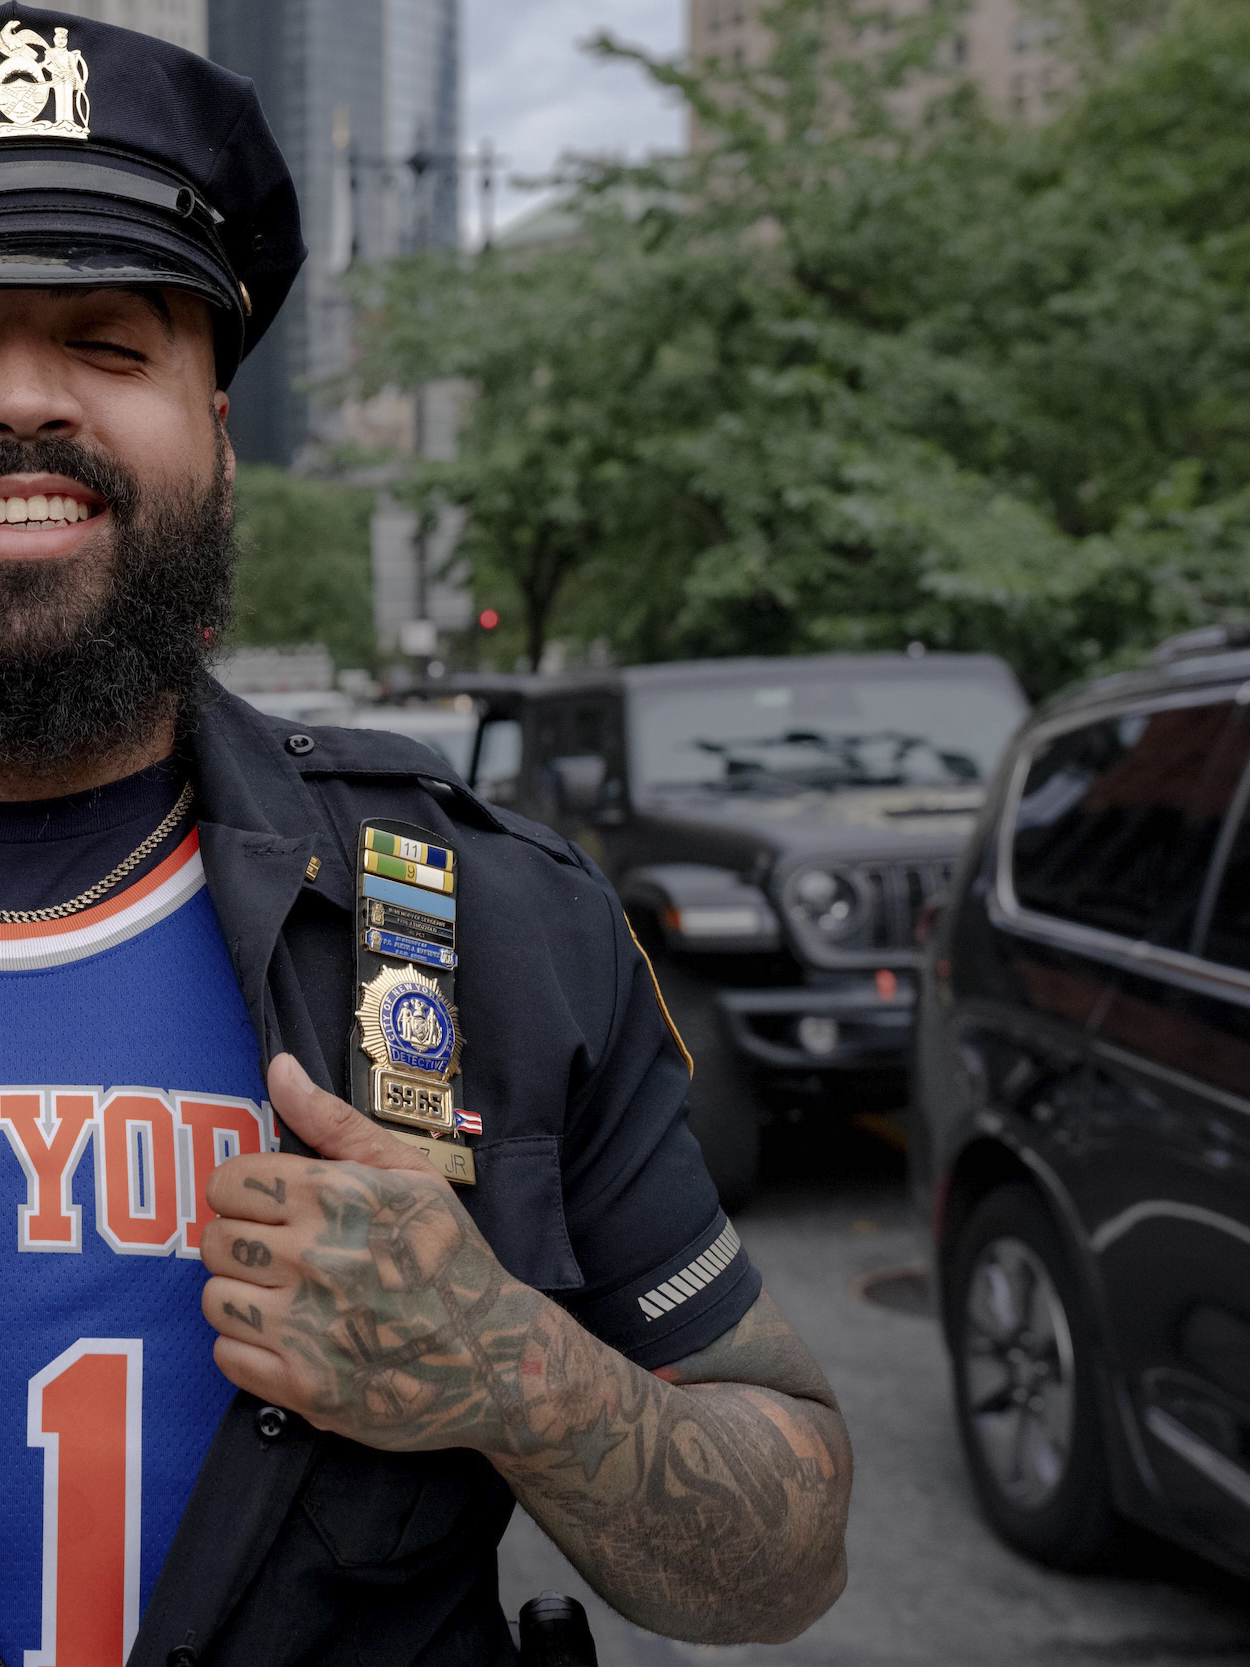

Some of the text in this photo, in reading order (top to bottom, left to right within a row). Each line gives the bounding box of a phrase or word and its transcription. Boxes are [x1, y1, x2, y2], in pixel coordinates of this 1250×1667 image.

[404, 842, 418, 858] 11
[407, 864, 415, 879] 9
[391, 983, 412, 997] NEW
[384, 996, 393, 1011] OF
[383, 1015, 395, 1041] CITY
[391, 1048, 447, 1070] DETECTIVE
[388, 1082, 443, 1118] 5965
[445, 1153, 467, 1176] JR
